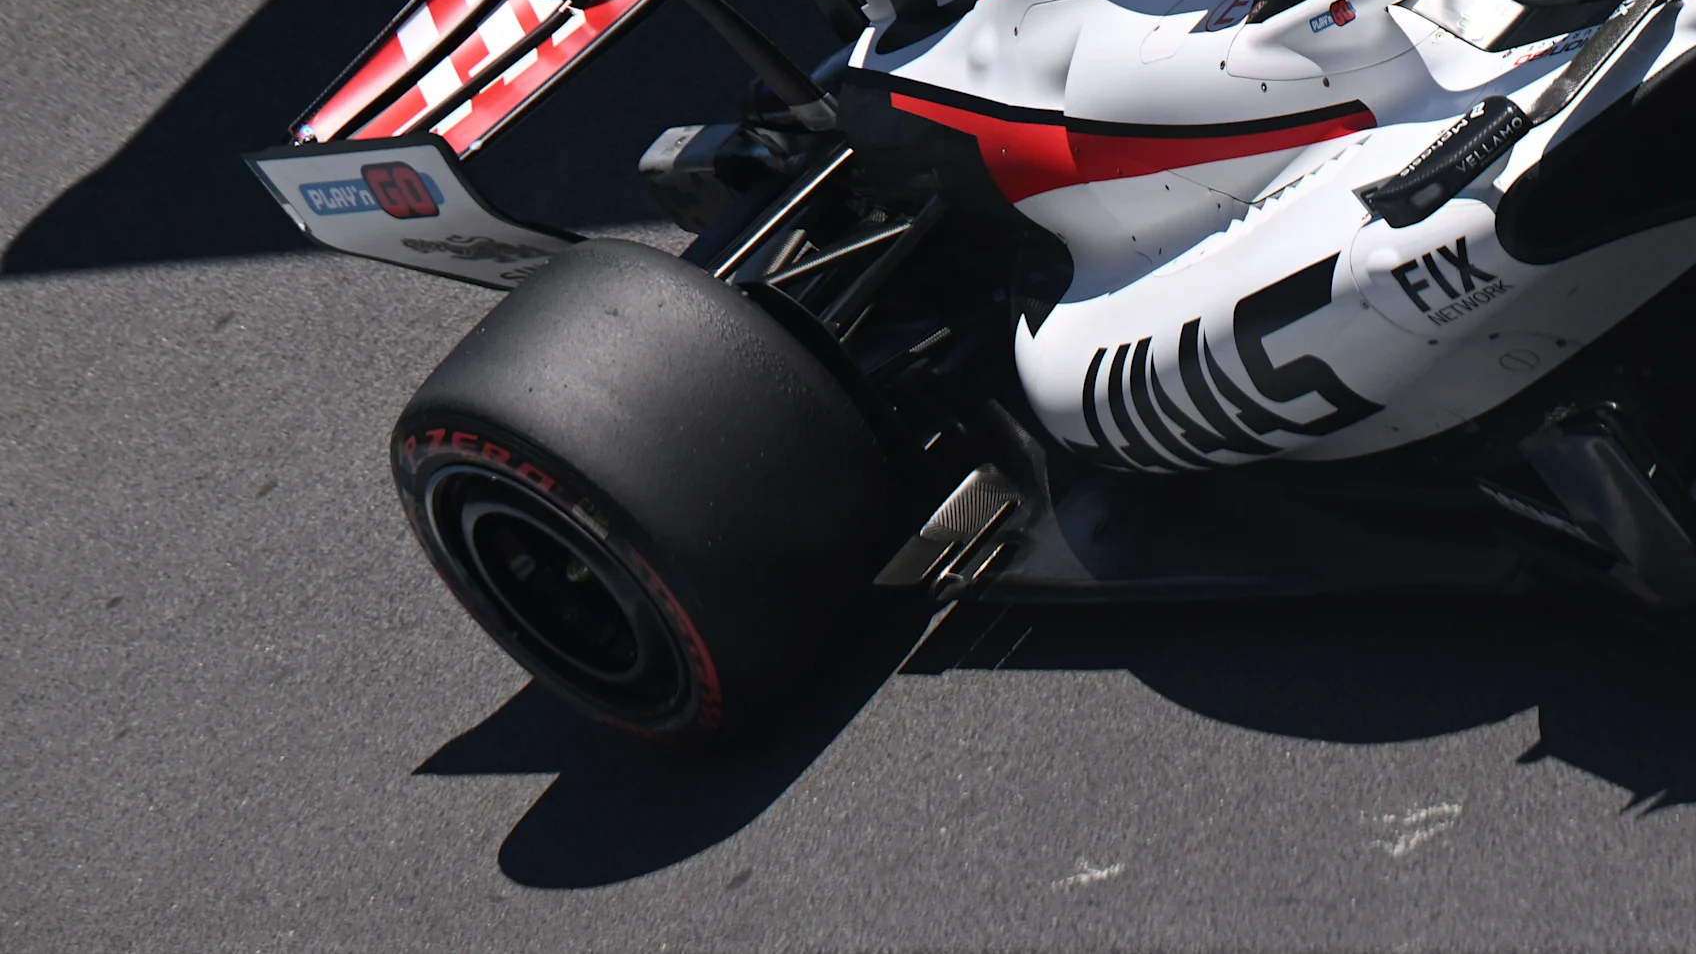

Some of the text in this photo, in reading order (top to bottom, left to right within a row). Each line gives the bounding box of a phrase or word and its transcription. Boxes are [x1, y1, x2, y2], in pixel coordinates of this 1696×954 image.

[1399, 118, 1469, 178] Mphasis
[1454, 116, 1524, 174] VELLAMO
[307, 164, 432, 215] PLAY'n GO
[1390, 235, 1496, 313] FIX
[1426, 278, 1513, 330] NETWORK
